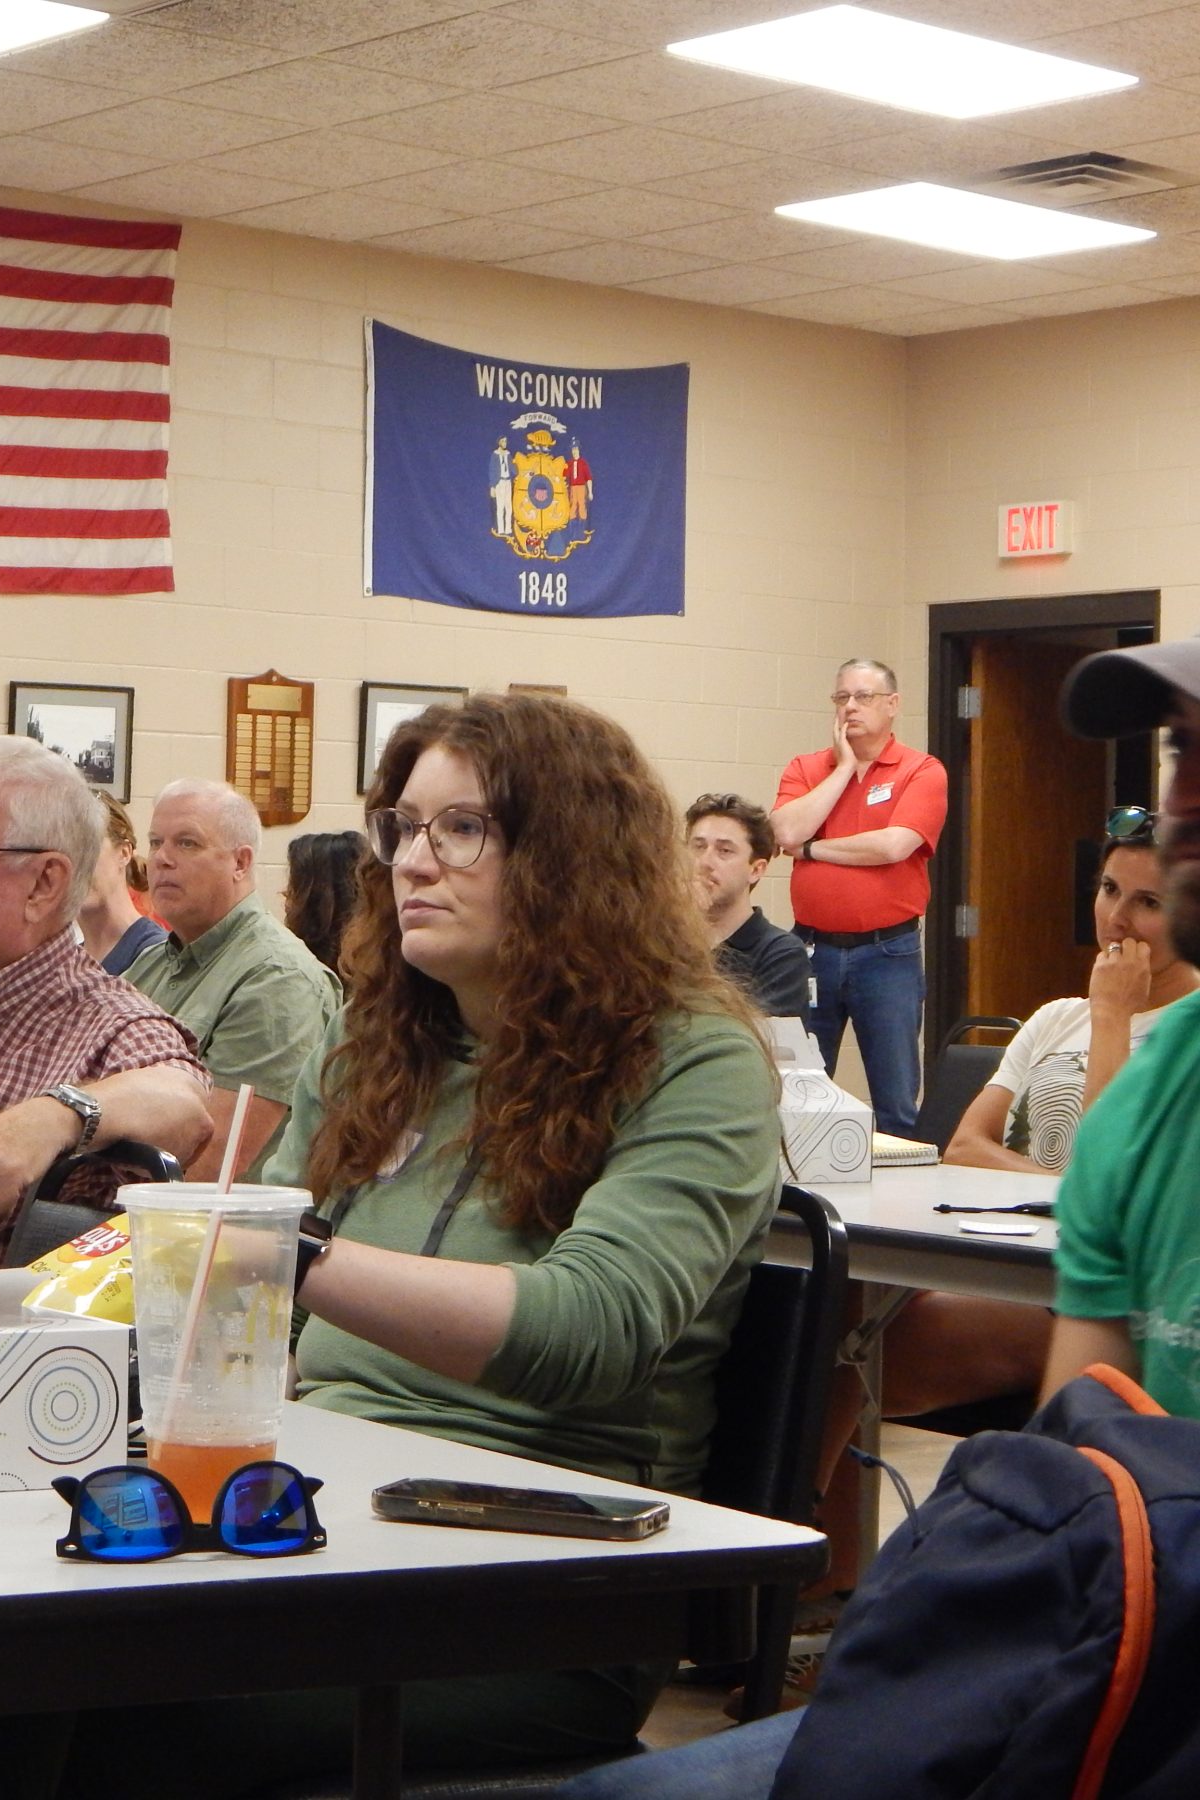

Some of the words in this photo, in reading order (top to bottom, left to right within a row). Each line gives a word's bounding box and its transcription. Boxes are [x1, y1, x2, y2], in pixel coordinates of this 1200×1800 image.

[475, 363, 603, 409] WISCONSIN
[523, 414, 557, 425] FORWARD
[1007, 504, 1059, 552] EXIT
[518, 571, 568, 607] 1848
